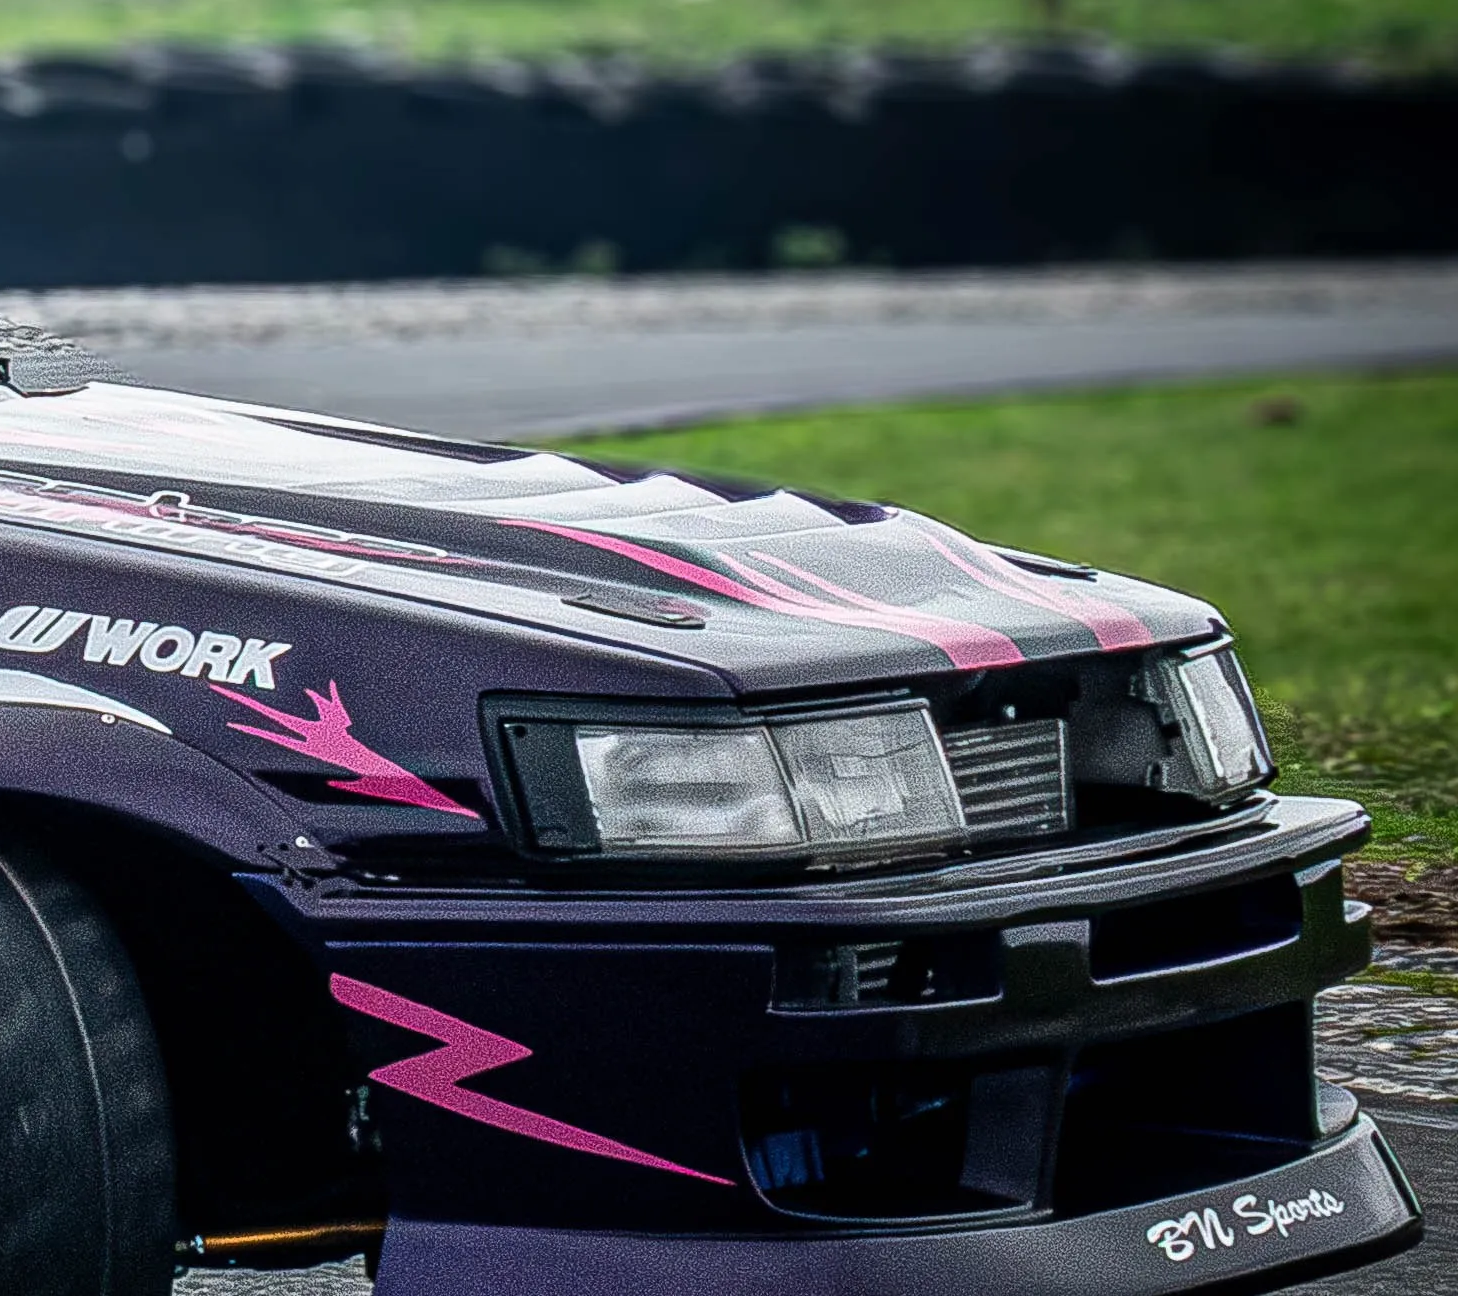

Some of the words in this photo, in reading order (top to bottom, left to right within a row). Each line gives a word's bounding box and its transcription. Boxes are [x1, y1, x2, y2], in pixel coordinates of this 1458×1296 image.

[83, 616, 293, 690] WORK
[1146, 1207, 1235, 1262] BN
[1232, 1188, 1345, 1238] Sports
